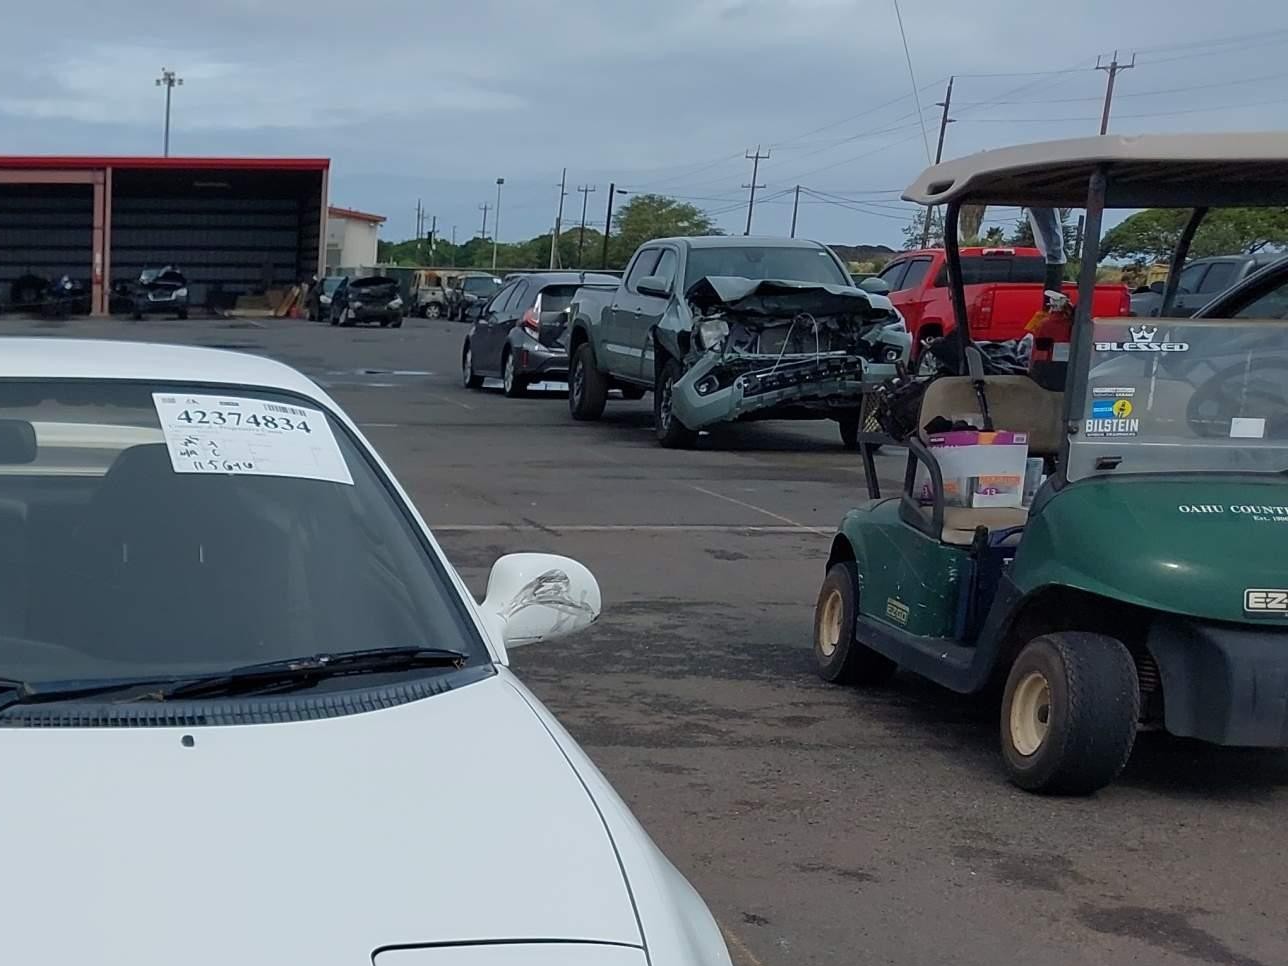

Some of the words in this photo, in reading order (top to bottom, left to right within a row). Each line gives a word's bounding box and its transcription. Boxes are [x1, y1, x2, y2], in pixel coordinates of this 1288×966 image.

[1095, 342, 1189, 351] BLESSED
[177, 410, 312, 433] 42374834
[1086, 419, 1139, 432] BILSTEIN
[1178, 505, 1224, 513] OAHU
